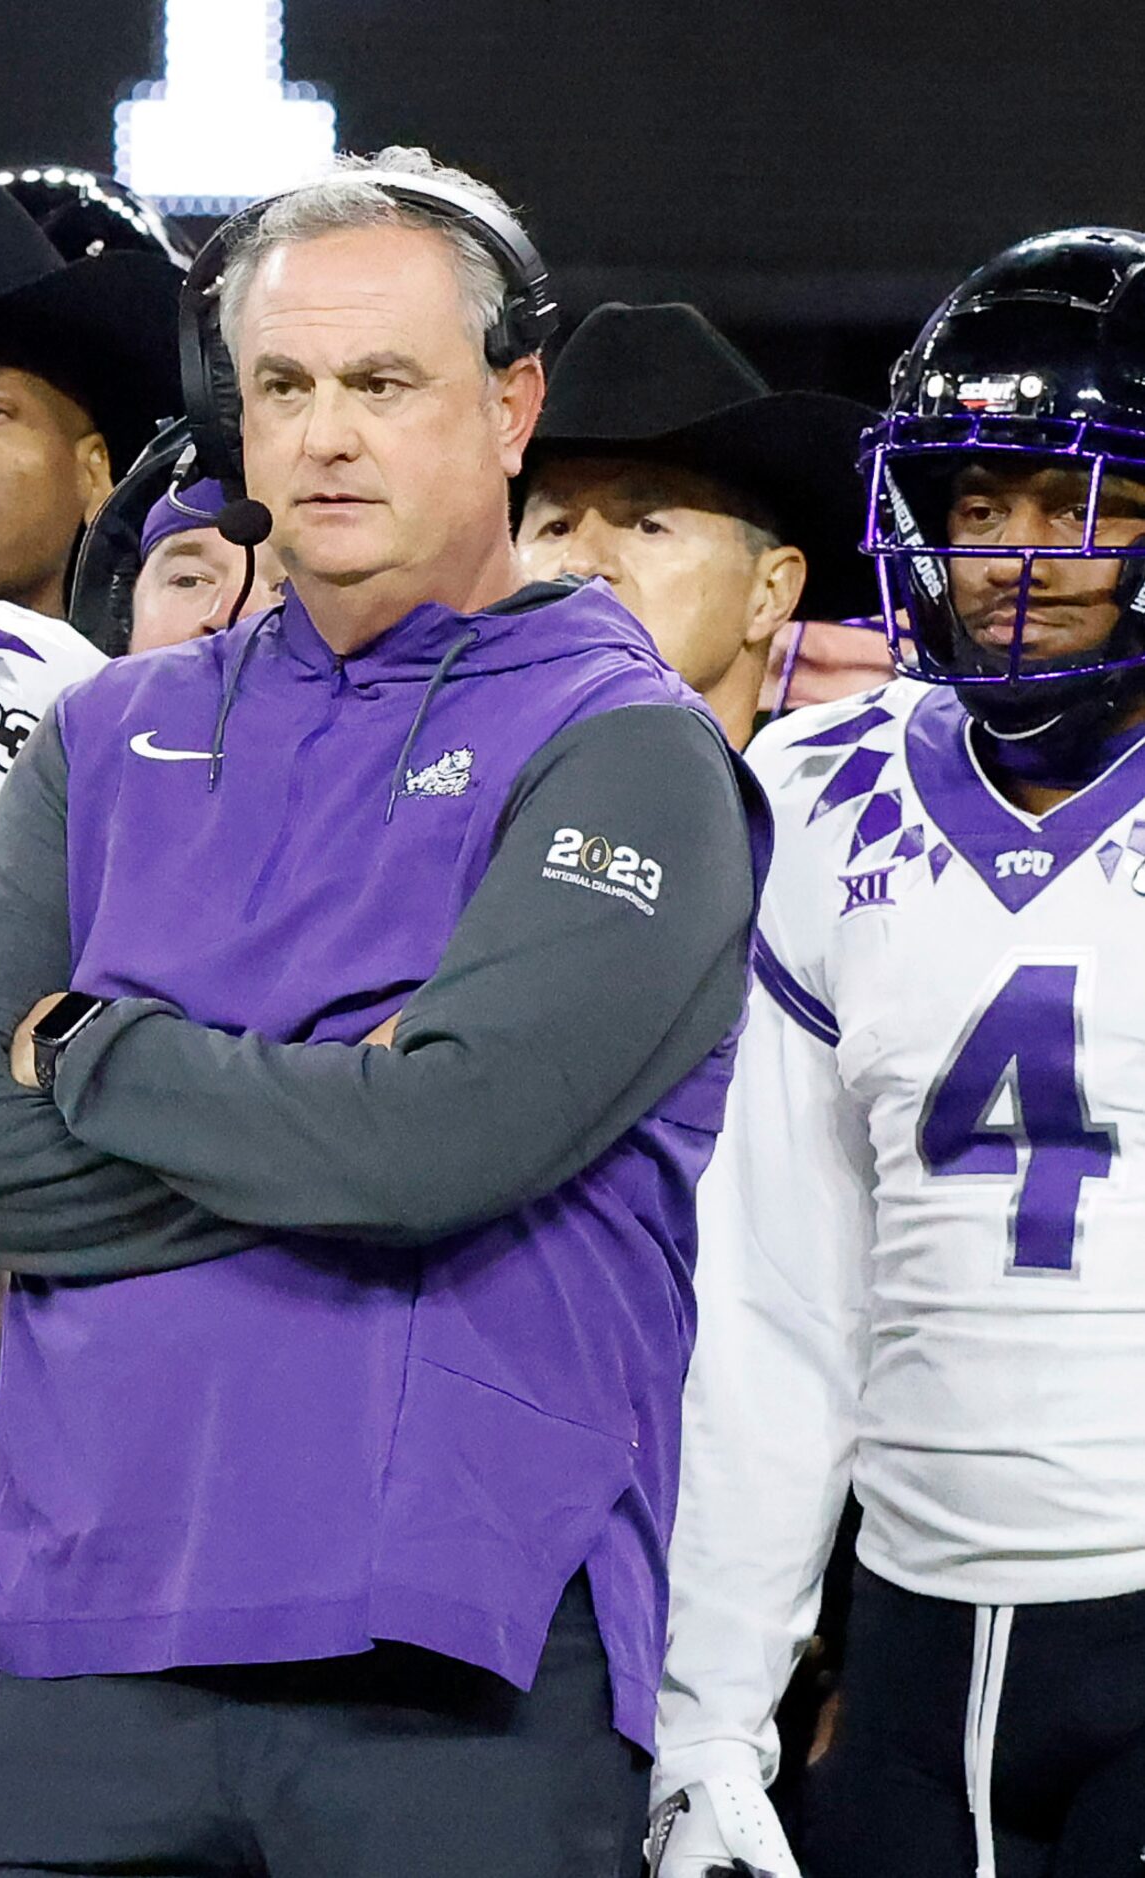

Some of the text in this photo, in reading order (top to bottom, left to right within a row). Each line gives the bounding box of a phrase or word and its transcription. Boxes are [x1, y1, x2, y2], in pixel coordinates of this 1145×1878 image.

[541, 866, 592, 889] NATIONAL
[545, 827, 663, 901] 2023
[838, 864, 897, 918] XII
[994, 849, 1054, 879] TCU
[918, 960, 1116, 1276] 4
